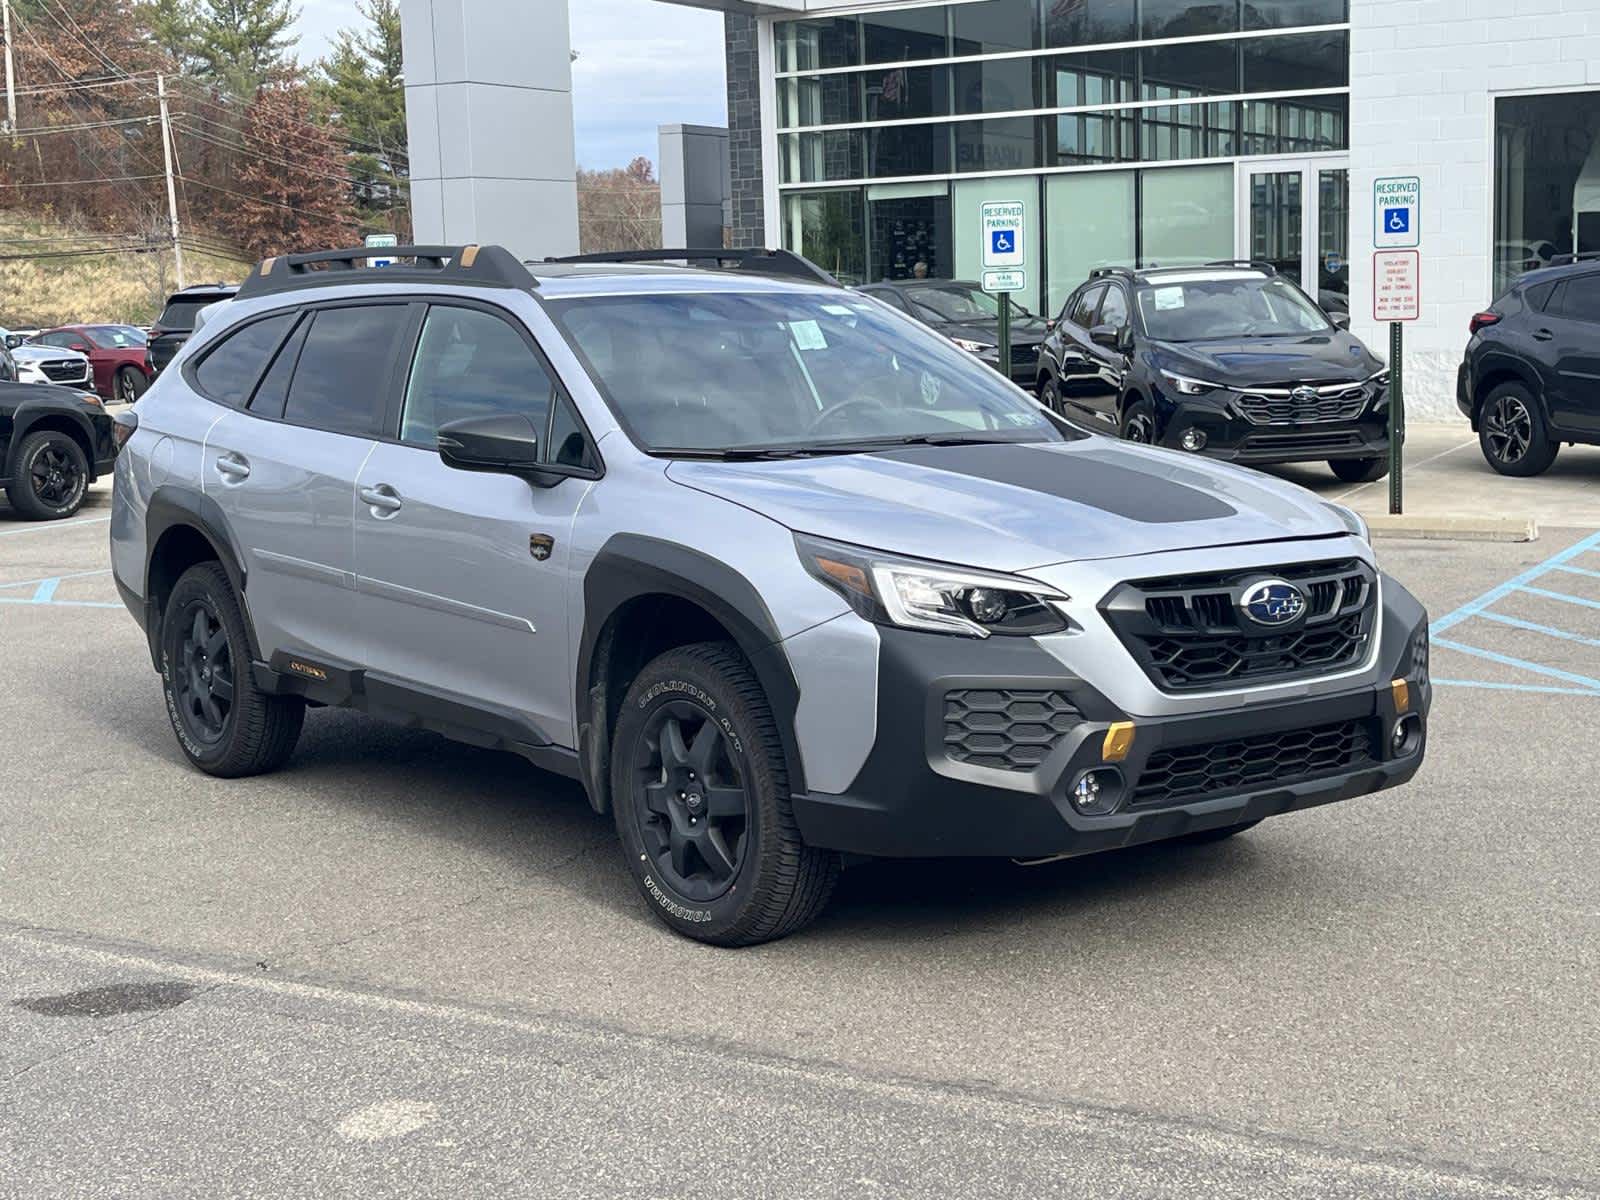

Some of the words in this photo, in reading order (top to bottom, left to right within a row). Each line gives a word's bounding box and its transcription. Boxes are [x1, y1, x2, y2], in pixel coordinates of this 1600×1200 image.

[1376, 183, 1418, 194] RESERVED
[1378, 195, 1415, 206] PARKING
[984, 207, 1021, 217] RESERVED
[986, 219, 1019, 228] PARKING
[643, 874, 712, 923] YOKOHAMA
